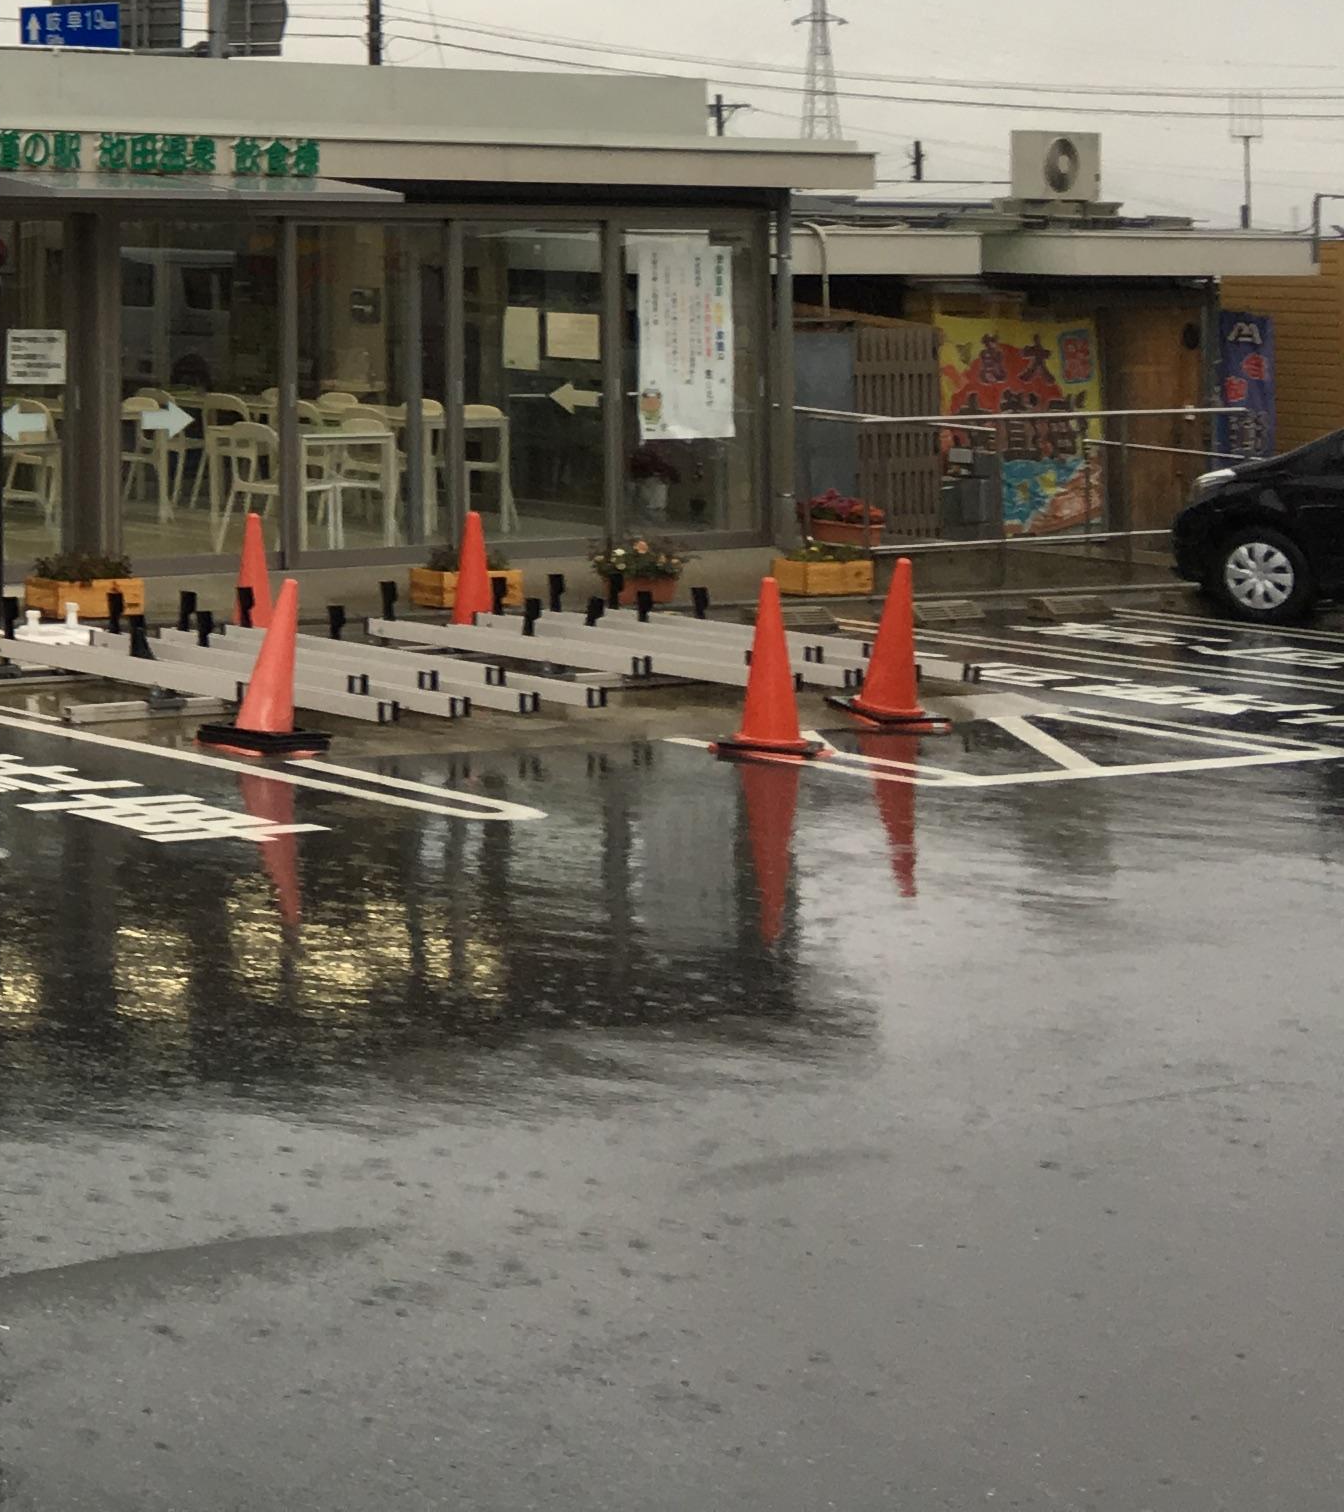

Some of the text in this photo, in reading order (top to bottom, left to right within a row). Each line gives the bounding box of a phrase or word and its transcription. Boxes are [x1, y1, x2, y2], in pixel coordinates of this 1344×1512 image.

[45, 11, 83, 31] 岐阜
[97, 132, 216, 174] 池田温泉
